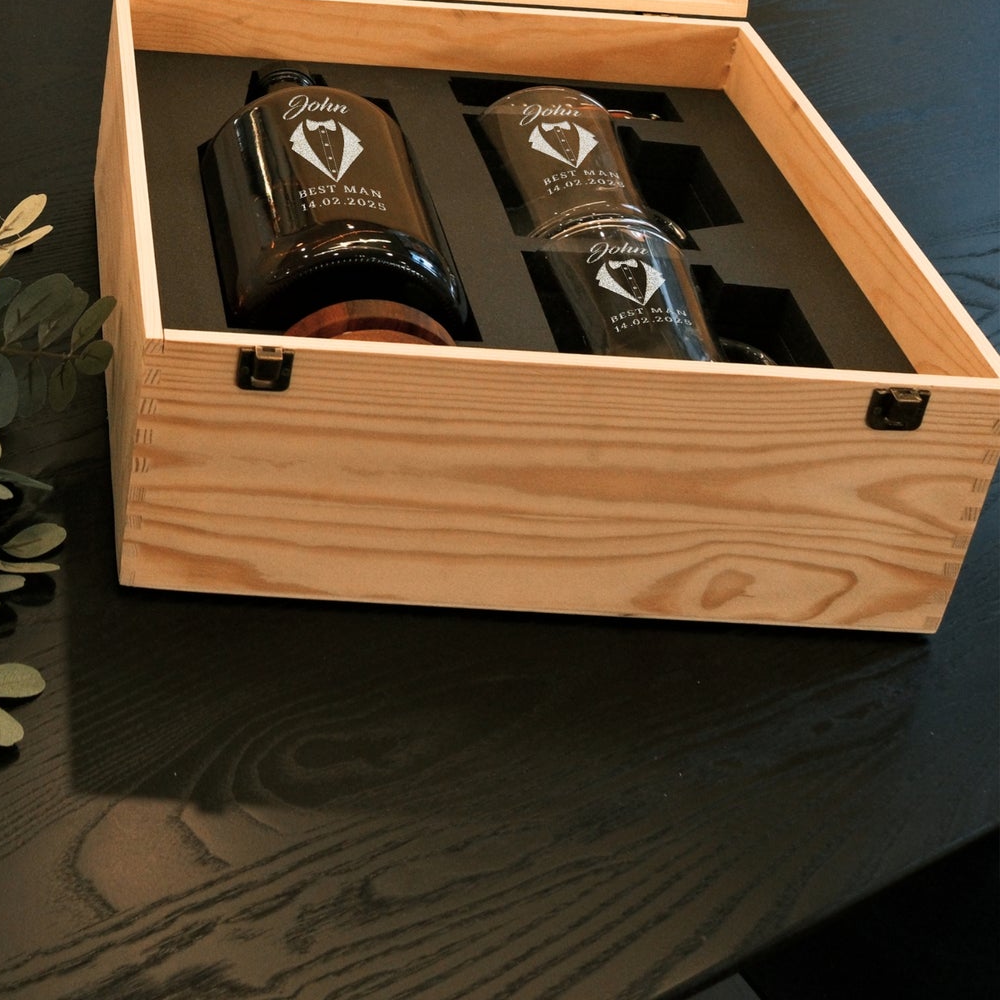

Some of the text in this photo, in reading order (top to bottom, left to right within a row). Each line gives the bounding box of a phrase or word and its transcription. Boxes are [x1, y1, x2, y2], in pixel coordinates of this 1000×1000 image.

[282, 94, 350, 121] John
[519, 104, 582, 126] John
[543, 169, 620, 186] BEST MAN
[298, 184, 382, 199] BEST MAN
[301, 197, 387, 212] 14.02.2025
[586, 241, 650, 264] John
[610, 307, 688, 324] BEST MAN
